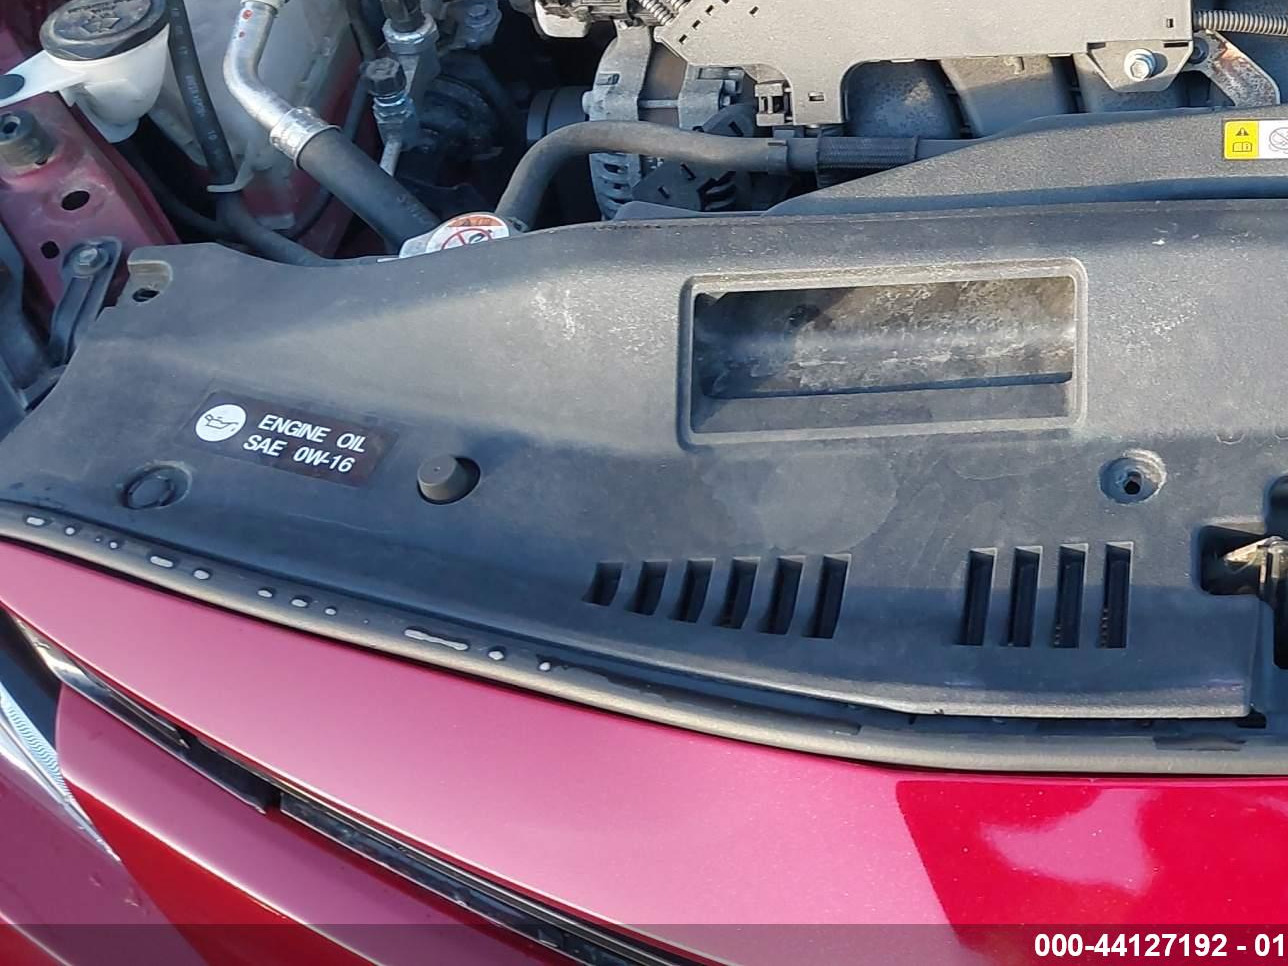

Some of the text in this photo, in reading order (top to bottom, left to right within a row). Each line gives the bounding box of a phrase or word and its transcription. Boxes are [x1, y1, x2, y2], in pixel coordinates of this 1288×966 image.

[258, 414, 368, 453] ENGINE OIL
[243, 435, 356, 473] SAE 0W-16
